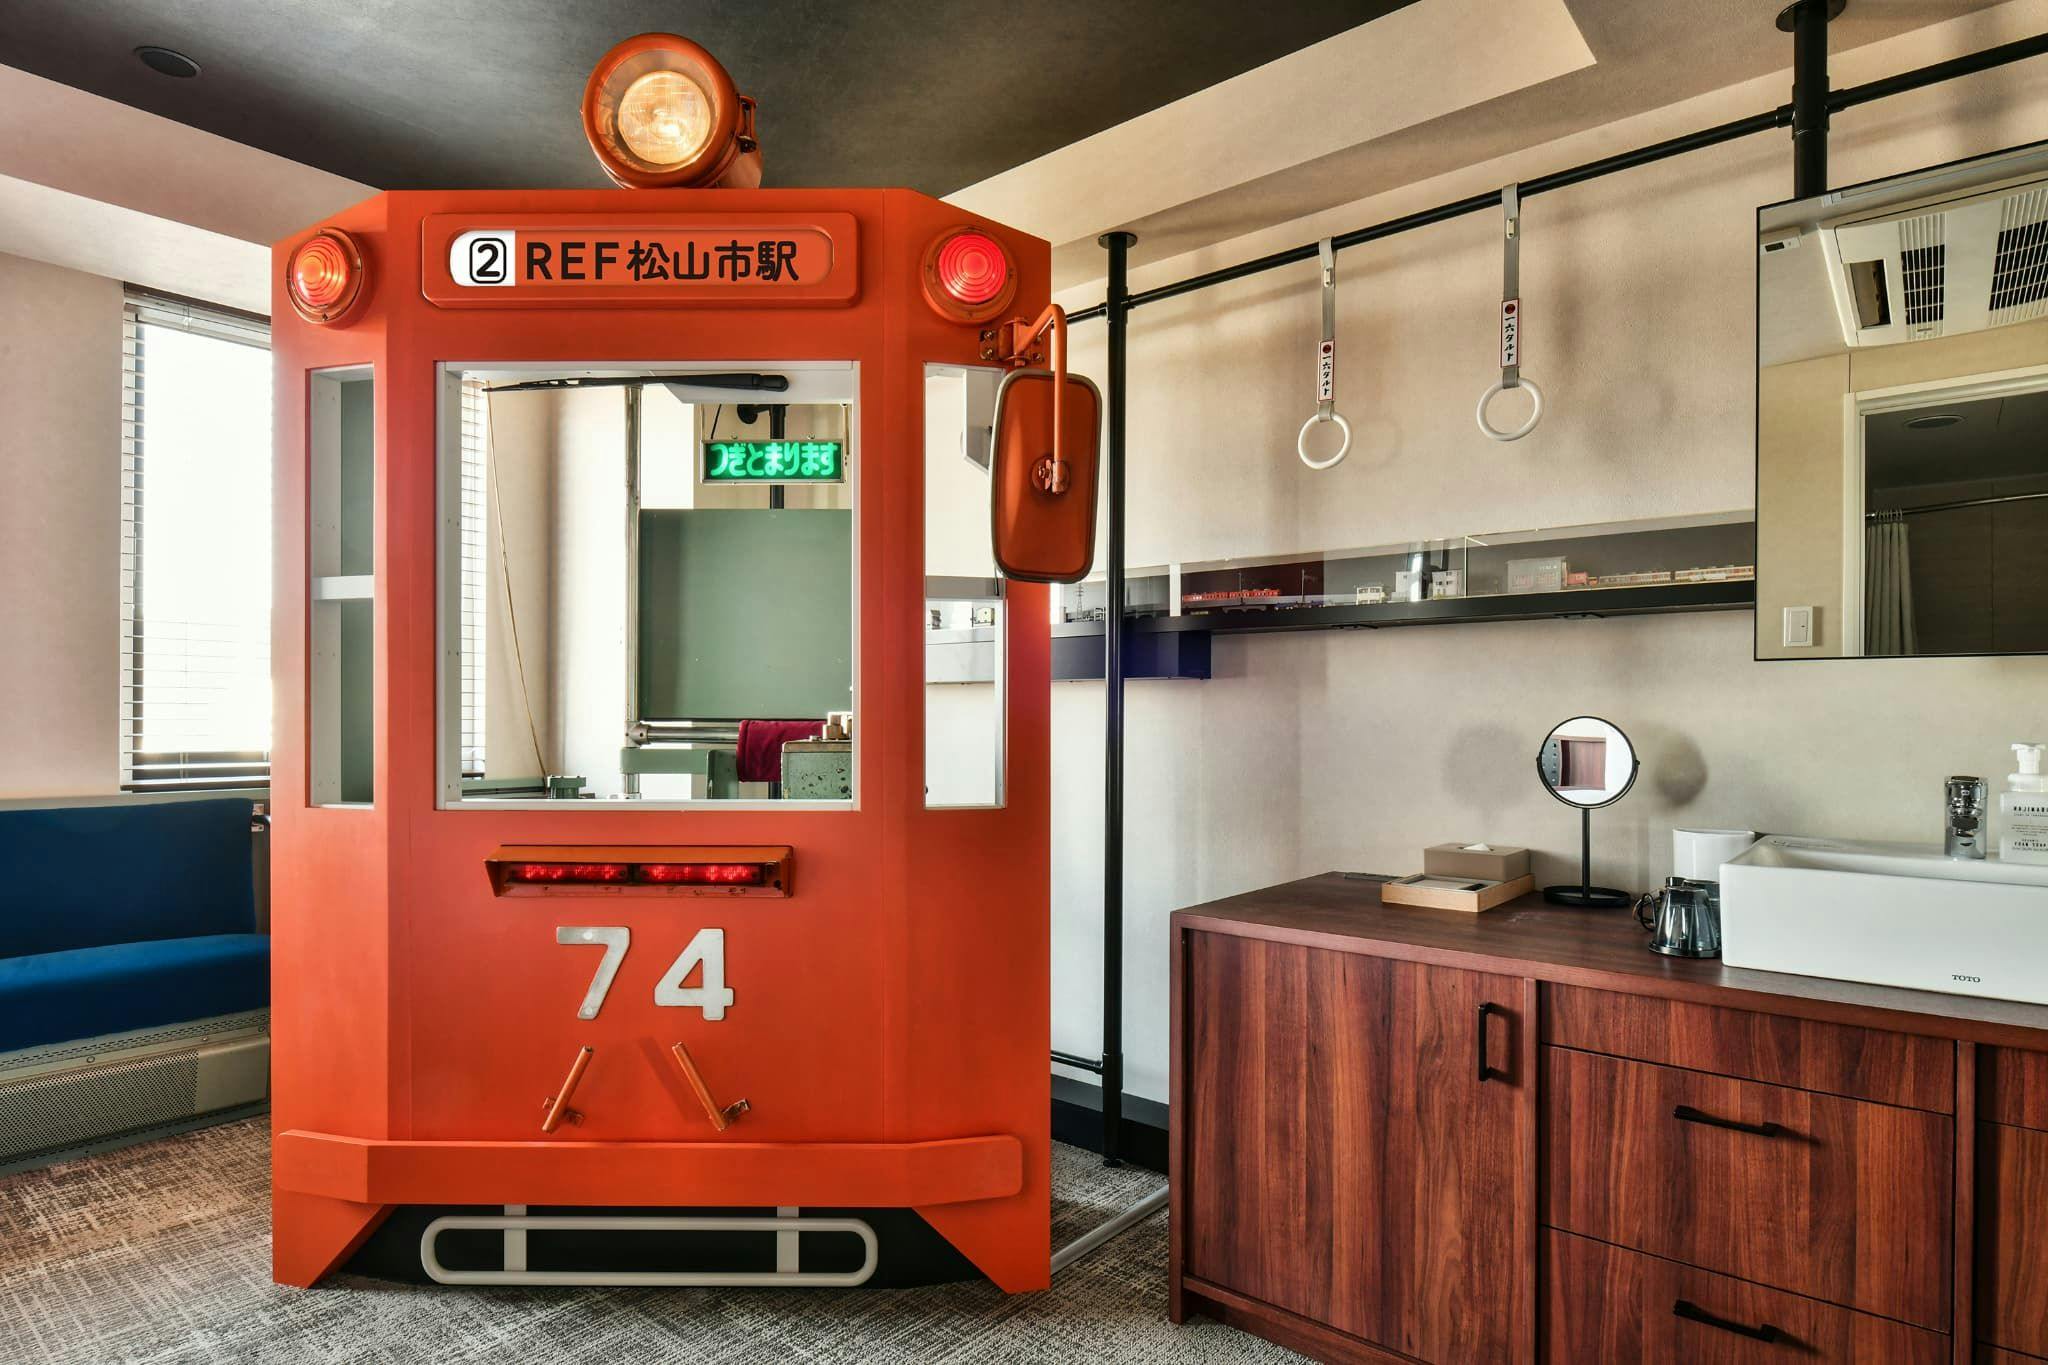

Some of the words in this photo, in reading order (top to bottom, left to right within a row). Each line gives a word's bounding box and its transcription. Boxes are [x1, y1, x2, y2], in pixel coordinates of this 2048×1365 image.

[475, 242, 502, 278] 2
[526, 239, 800, 282] REF松山市駅
[1503, 316, 1516, 362] 一六タルト
[1322, 355, 1332, 396] 一六タルト
[710, 441, 838, 476] つぎとまります
[556, 926, 734, 1021] 74
[1951, 974, 1981, 983] TOTO
